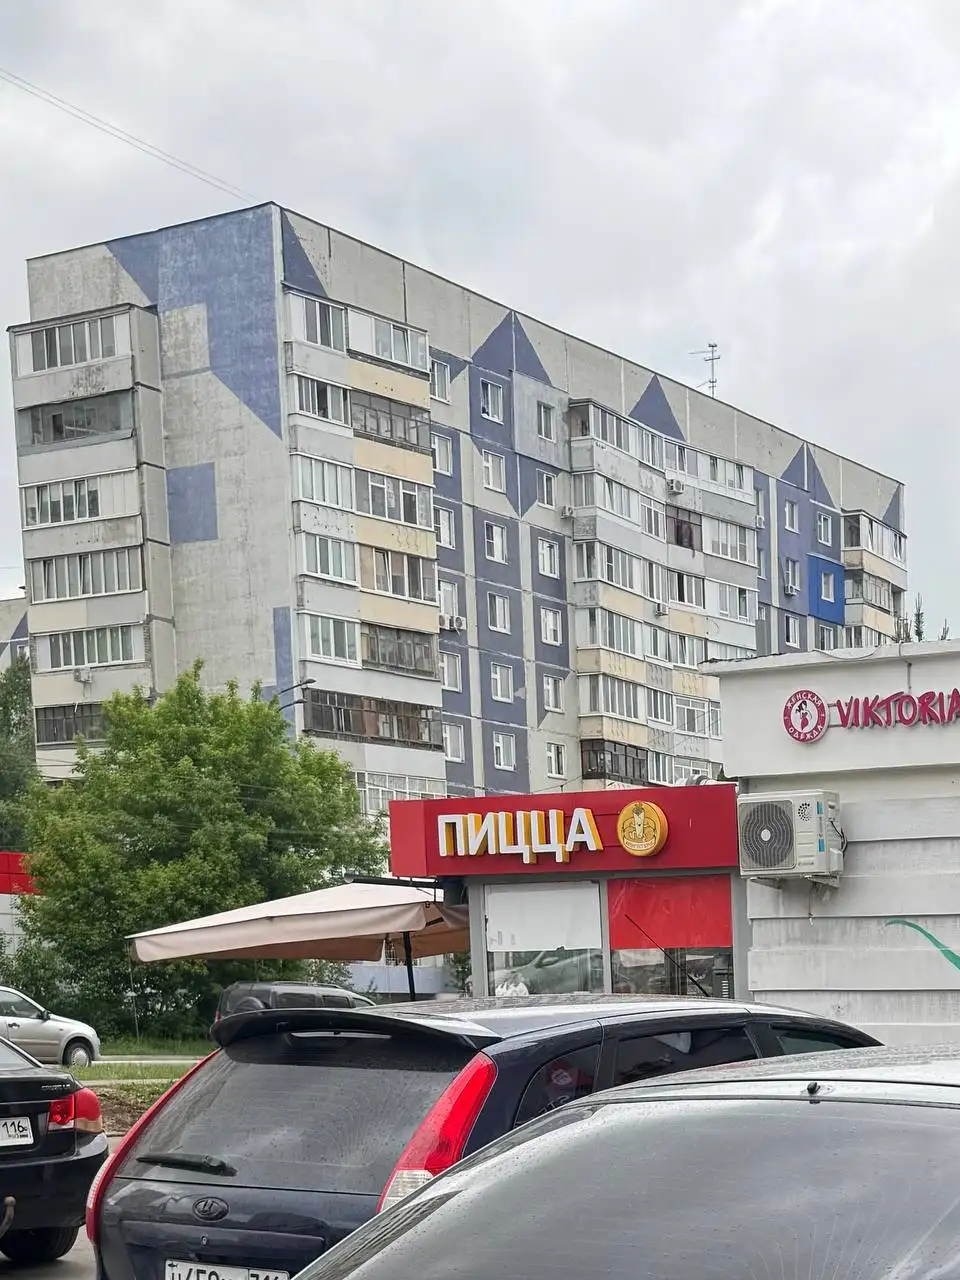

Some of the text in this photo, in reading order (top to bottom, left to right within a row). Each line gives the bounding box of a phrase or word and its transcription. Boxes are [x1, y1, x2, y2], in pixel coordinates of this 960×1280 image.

[786, 691, 823, 710] ЖЕНСКАЯ
[788, 724, 824, 741] ОДЕЖДА
[437, 807, 604, 864] ПИЦЦА
[2, 1120, 26, 1133] 116
